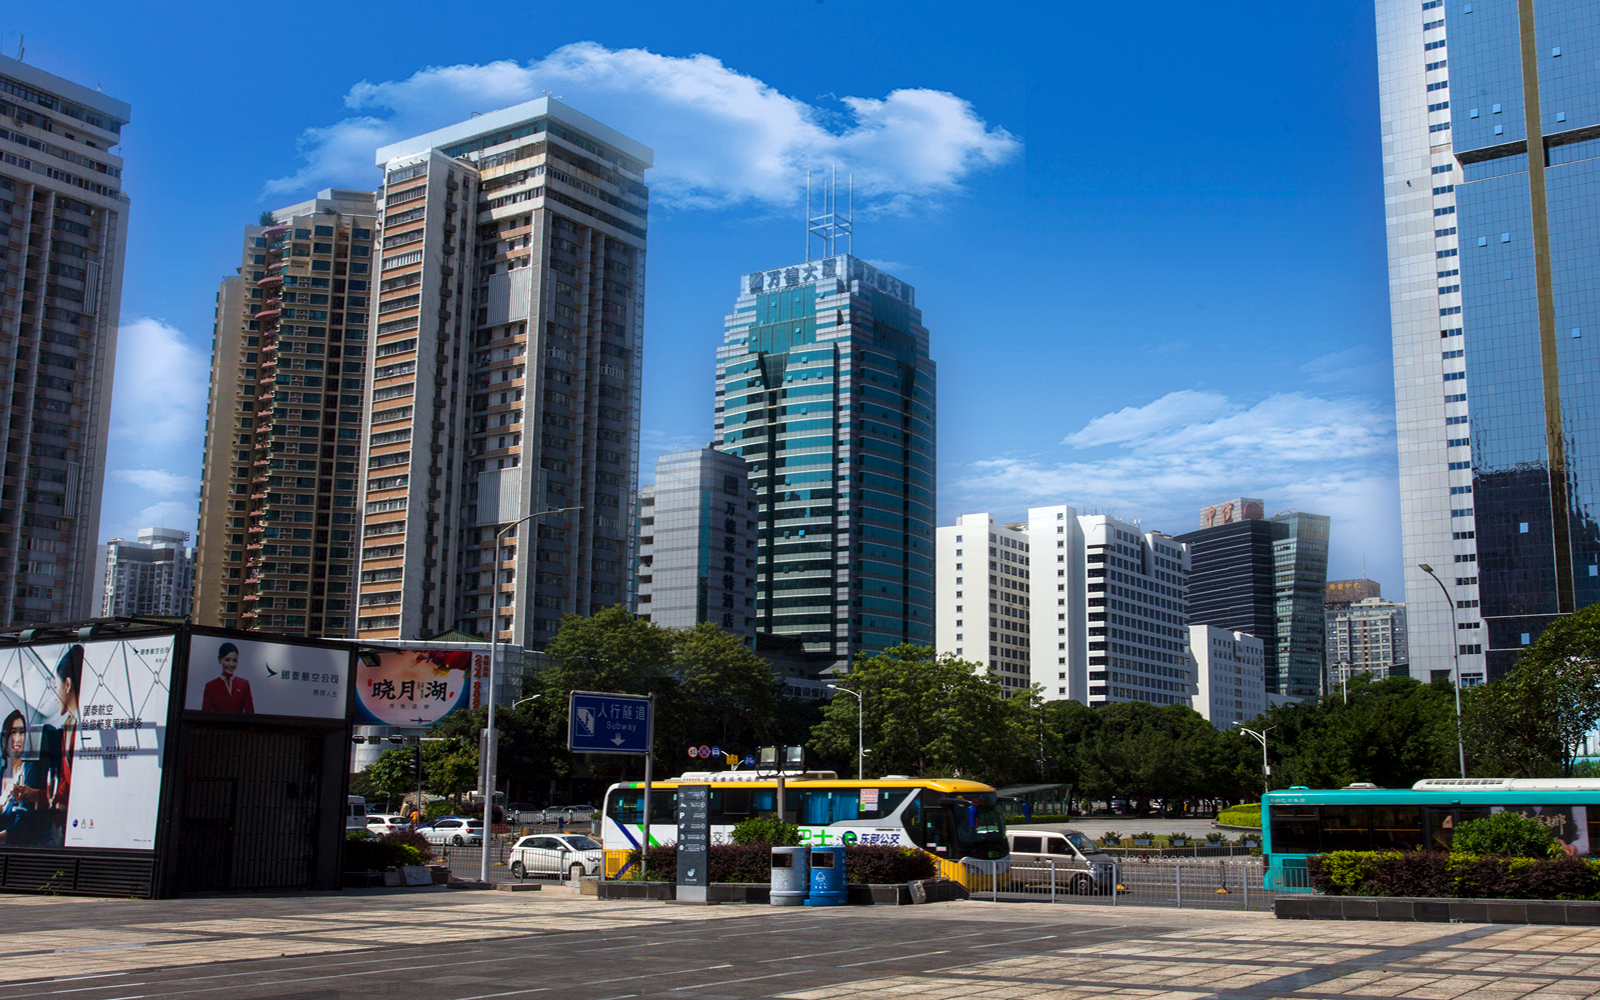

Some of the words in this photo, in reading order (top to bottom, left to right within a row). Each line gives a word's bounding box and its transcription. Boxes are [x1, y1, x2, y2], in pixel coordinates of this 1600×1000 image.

[767, 258, 837, 288] 万德大厦
[371, 679, 448, 702] 晓月湖
[781, 685, 828, 698] 国建设银行
[83, 704, 114, 716] 国泰航空
[597, 702, 646, 721] 人行隧道
[606, 720, 637, 733] Subway
[860, 833, 901, 845] 东部公交
